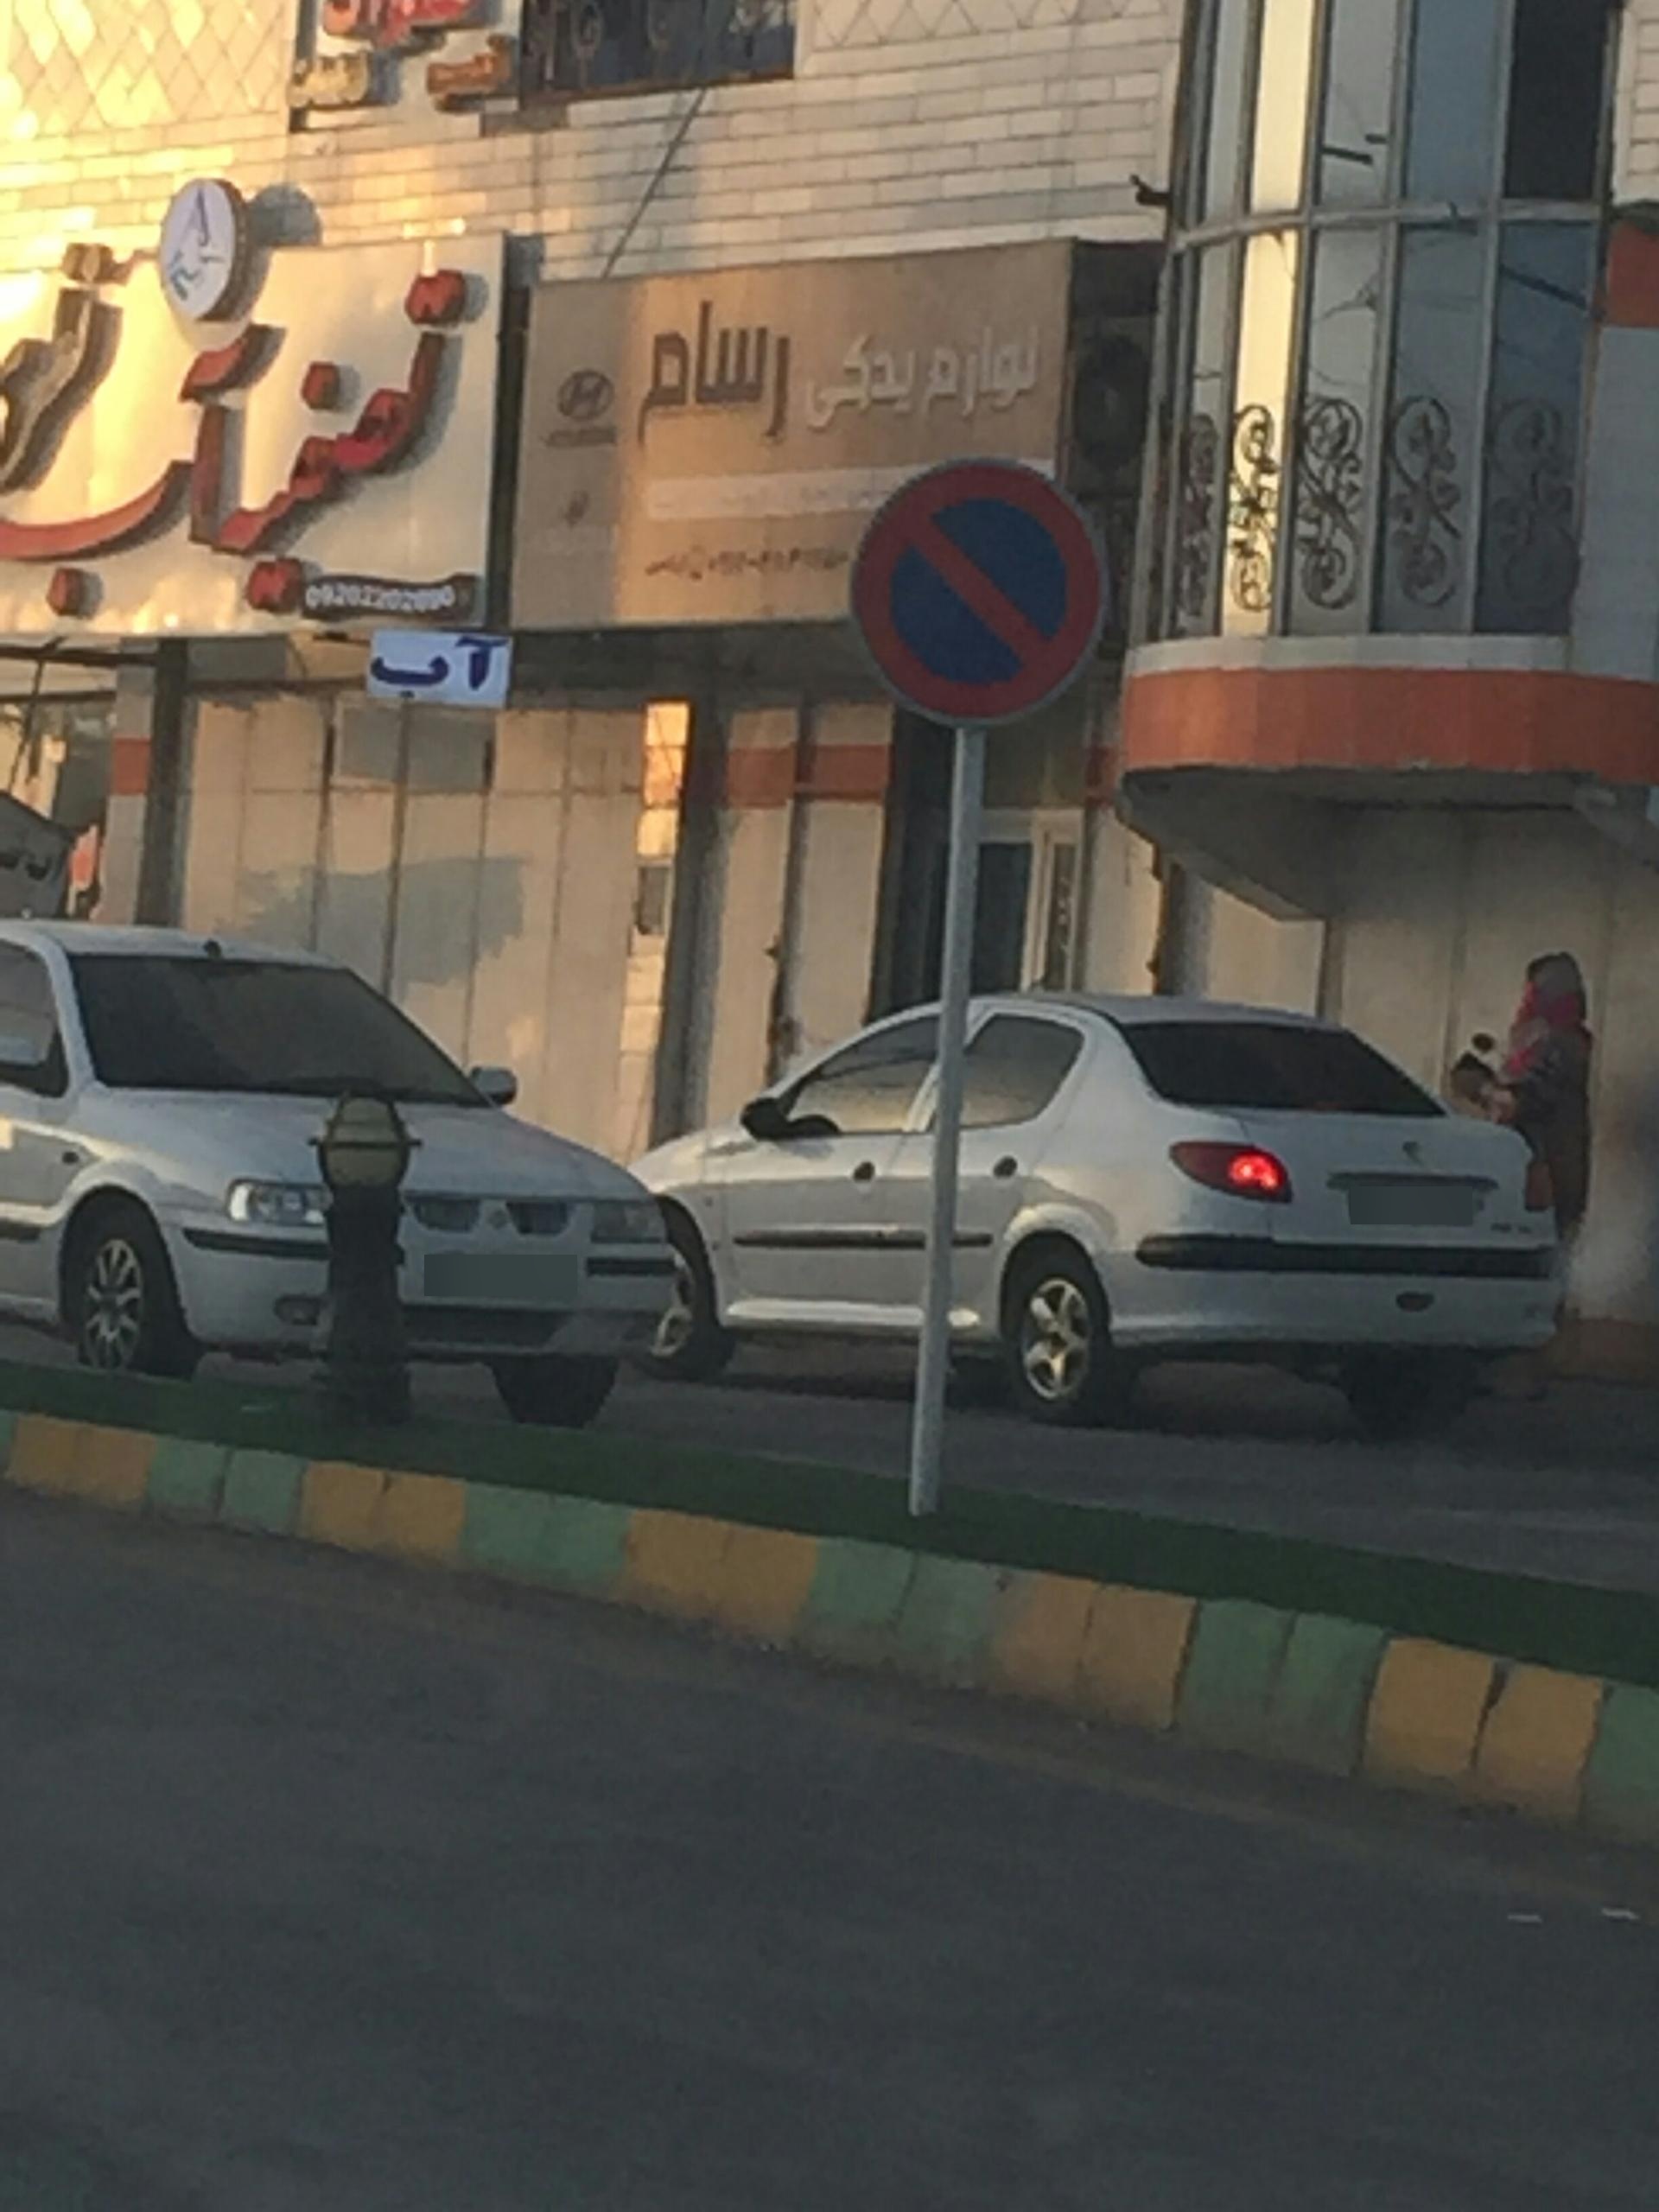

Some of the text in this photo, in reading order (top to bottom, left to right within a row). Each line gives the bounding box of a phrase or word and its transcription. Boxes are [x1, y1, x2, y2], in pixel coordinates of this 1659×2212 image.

[637, 299, 791, 448] رسام
[804, 332, 916, 432] یدکی
[370, 636, 511, 698] آب
